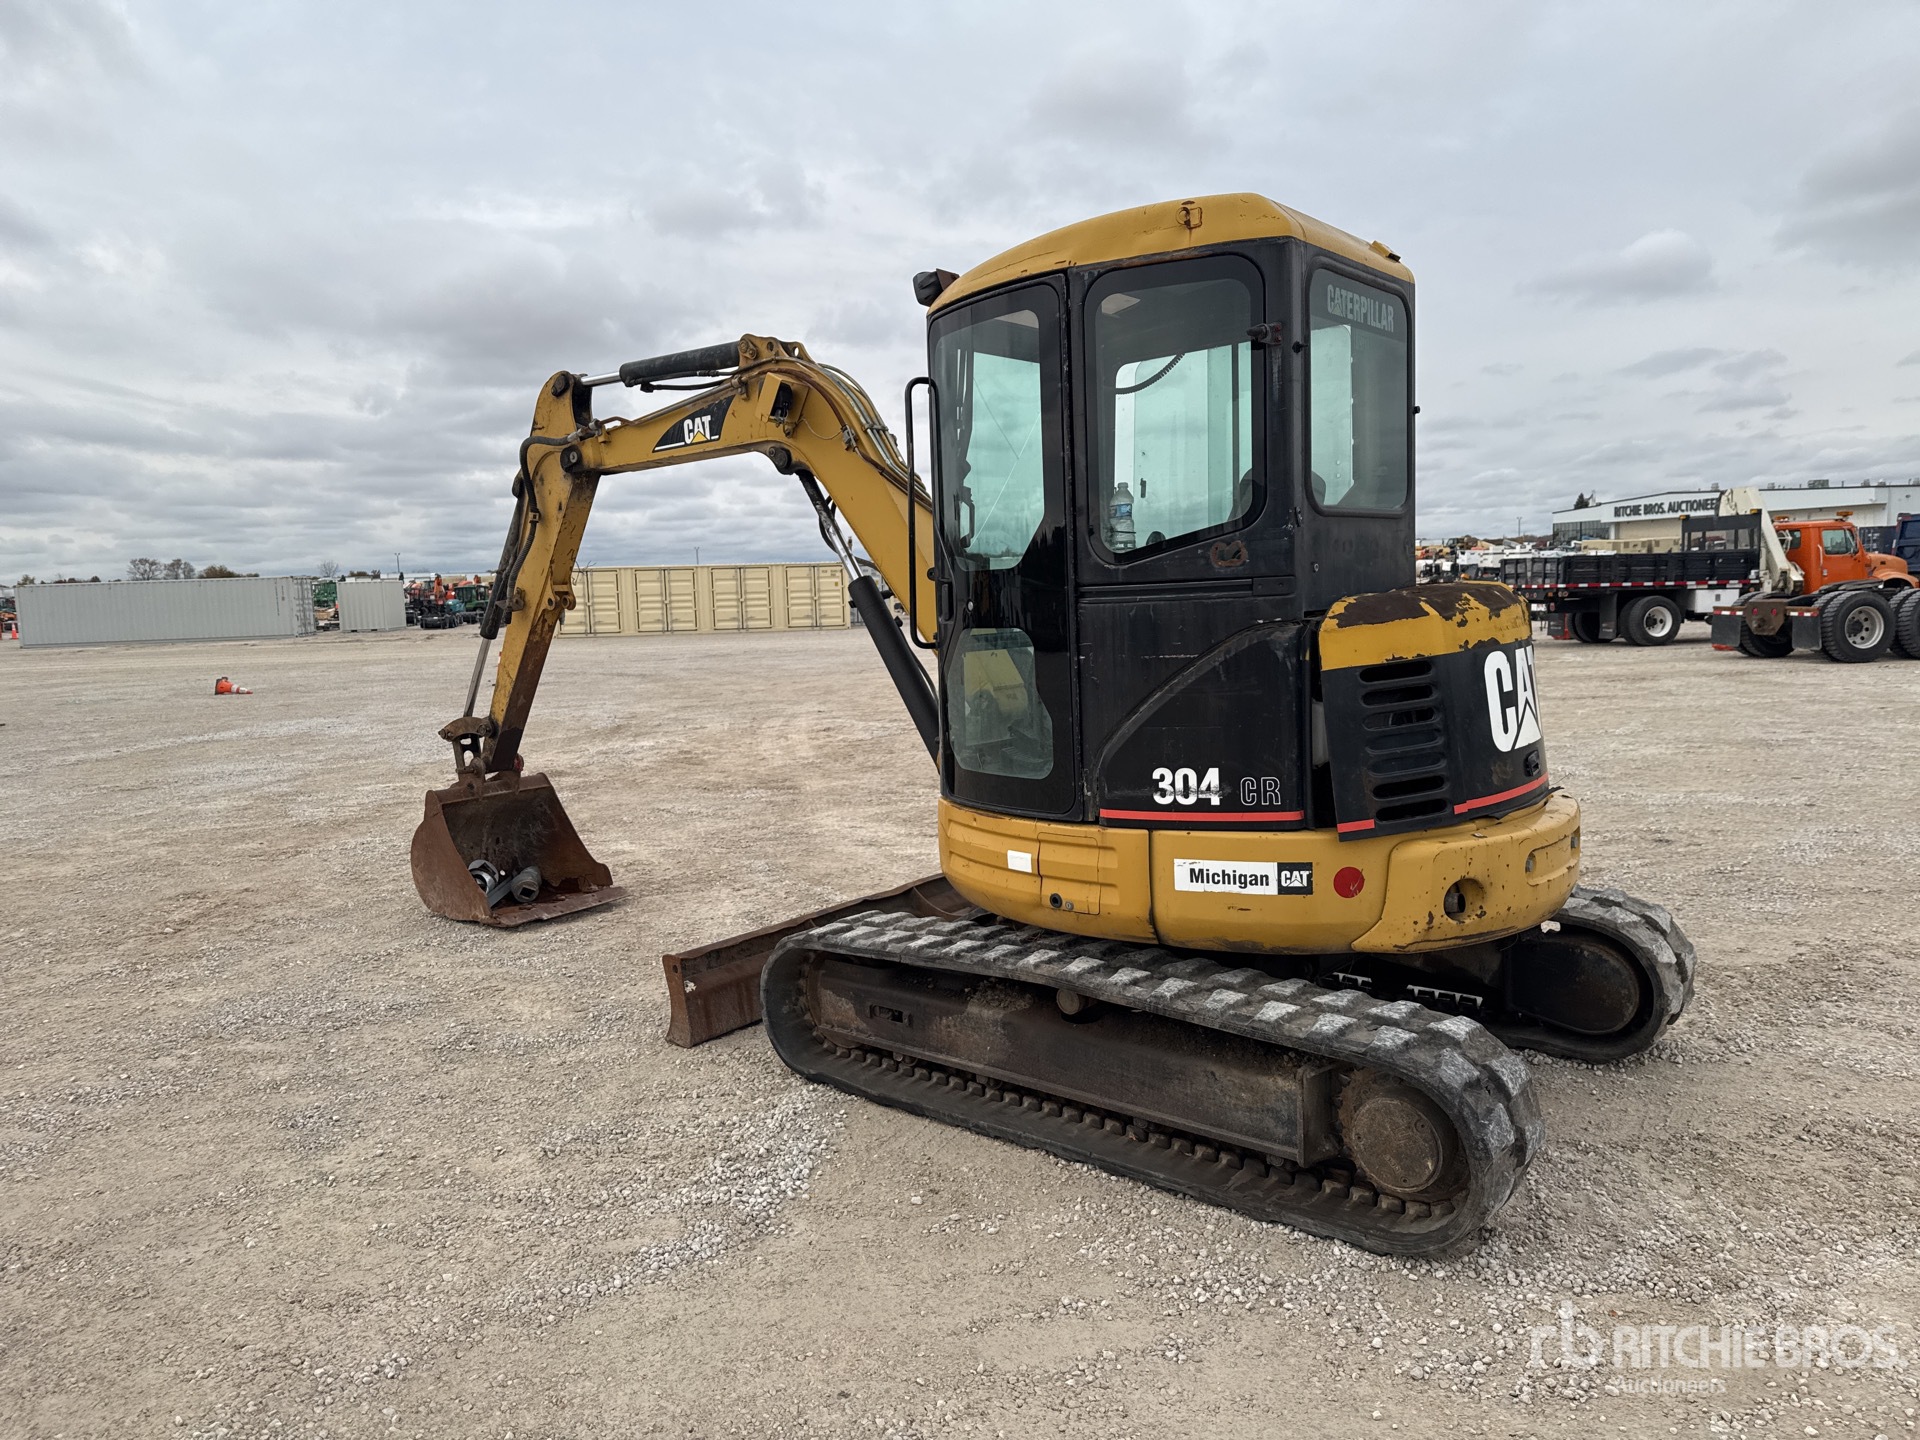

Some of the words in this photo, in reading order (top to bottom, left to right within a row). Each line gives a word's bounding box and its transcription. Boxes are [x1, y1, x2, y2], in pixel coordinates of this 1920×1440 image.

[1327, 284, 1394, 333] CATERPILLAR
[683, 414, 711, 445] CAT
[1614, 504, 1642, 518] RITCHIE
[1643, 502, 1666, 515] BROS.
[1152, 767, 1221, 806] 304
[1240, 776, 1282, 806] CR
[1189, 867, 1270, 889] Michigan
[1280, 870, 1311, 888] CAT
